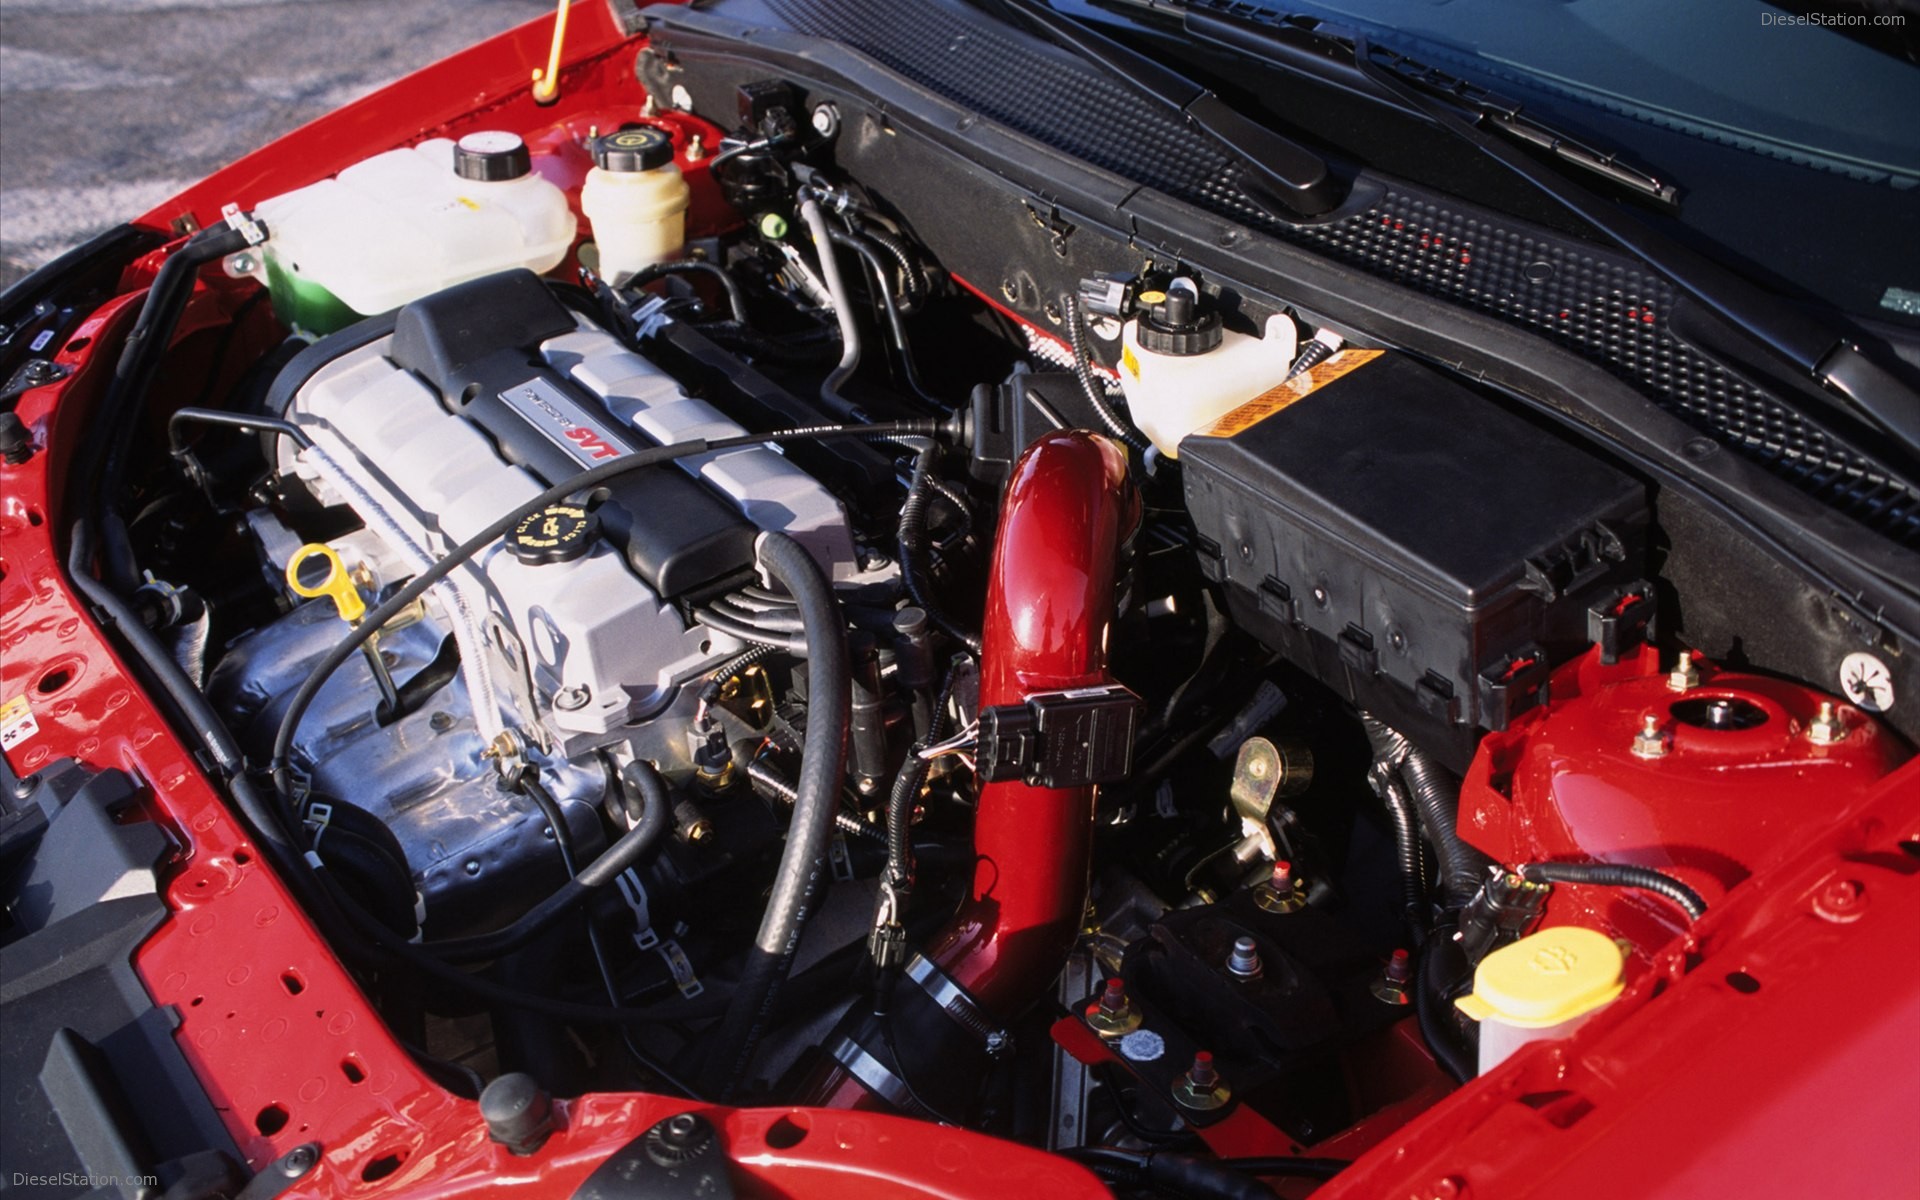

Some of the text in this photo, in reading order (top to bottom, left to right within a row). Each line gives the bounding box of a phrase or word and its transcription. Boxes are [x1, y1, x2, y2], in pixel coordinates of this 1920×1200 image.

[564, 427, 620, 460] SVT
[516, 513, 542, 533] CLICK
[561, 520, 587, 542] CLICK
